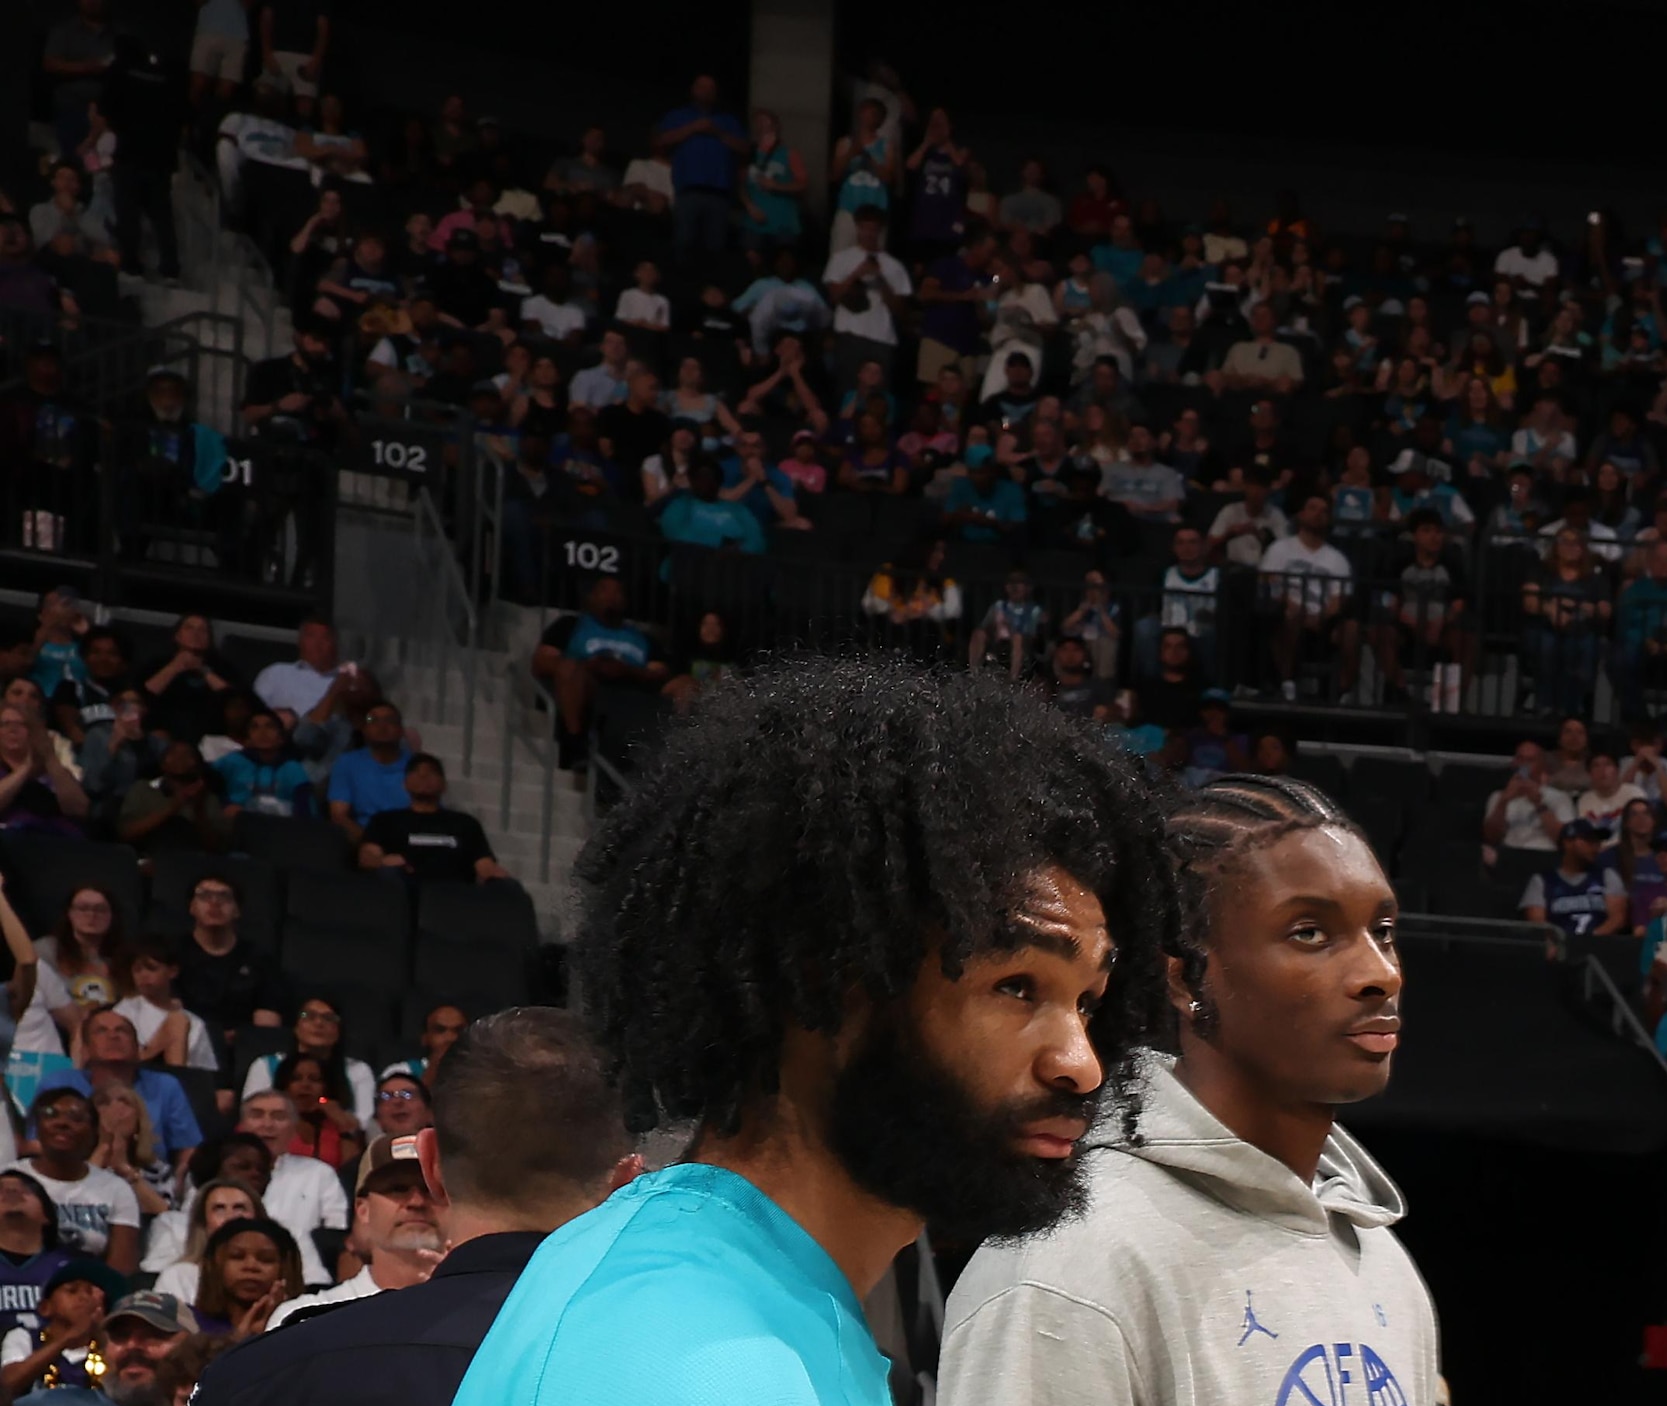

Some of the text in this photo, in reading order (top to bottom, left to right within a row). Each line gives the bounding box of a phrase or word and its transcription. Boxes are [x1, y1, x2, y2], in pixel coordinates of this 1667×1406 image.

[220, 457, 252, 487] 01
[371, 440, 428, 473] 102
[563, 539, 621, 574] 102
